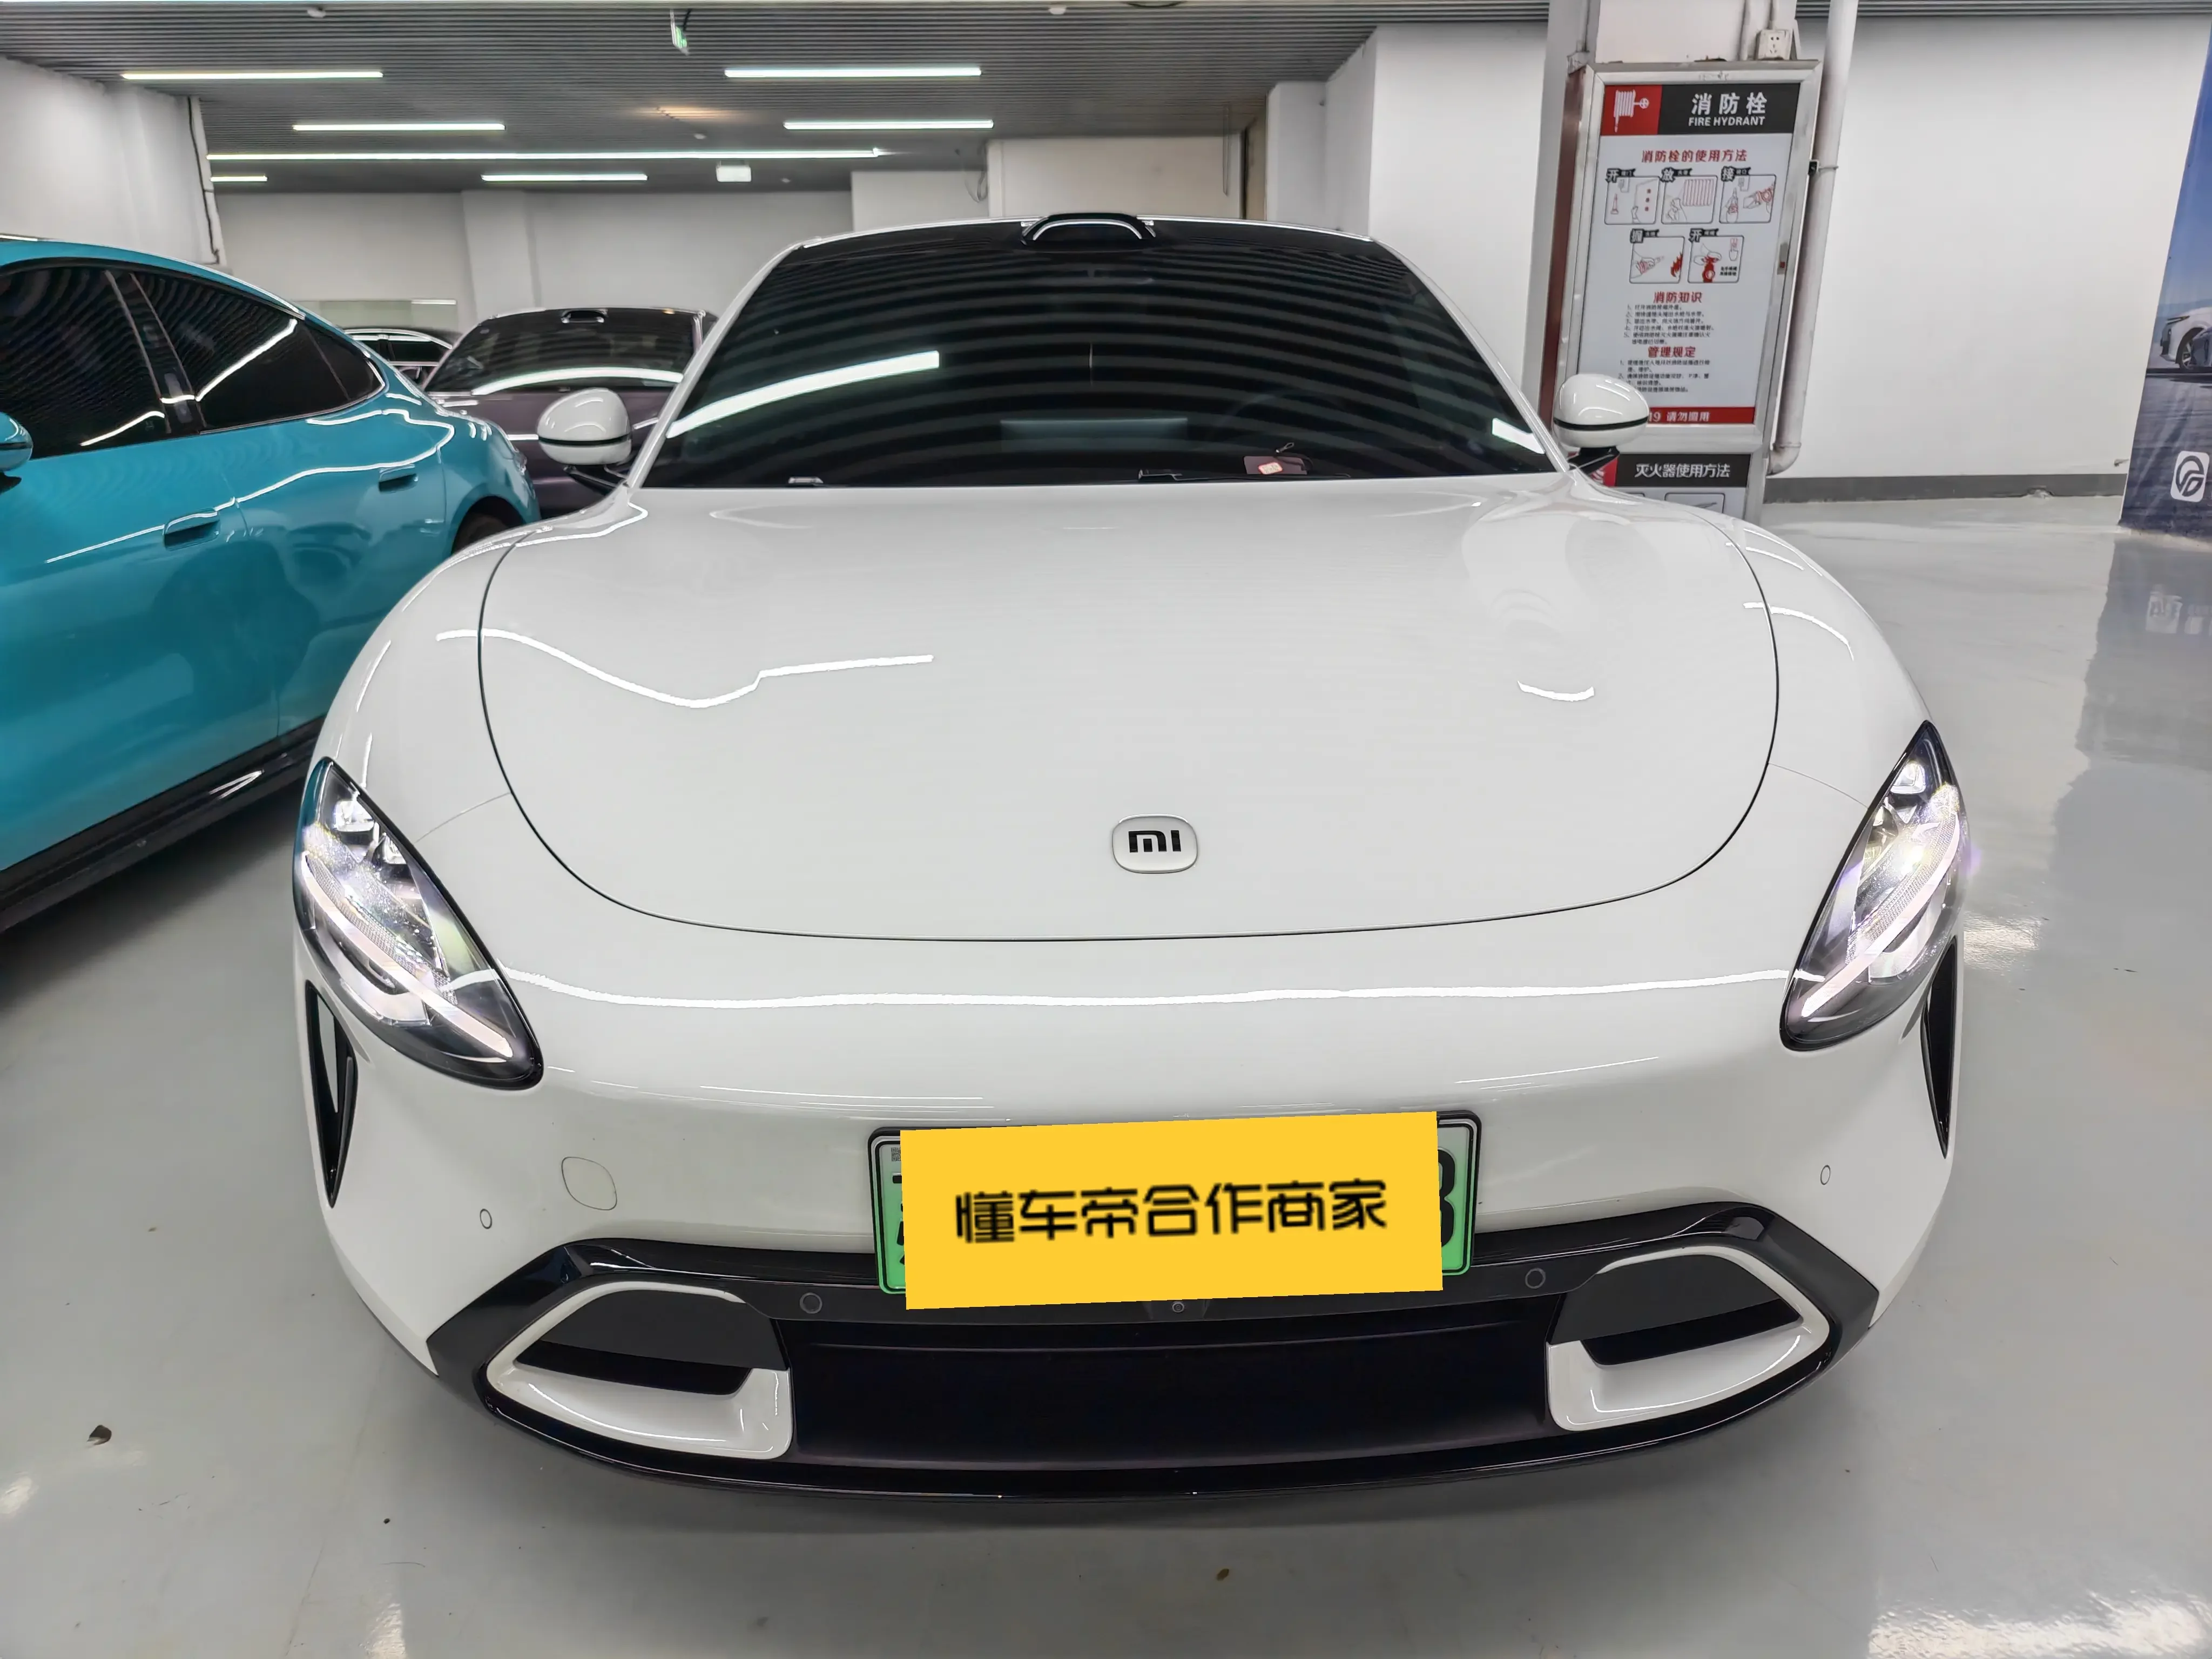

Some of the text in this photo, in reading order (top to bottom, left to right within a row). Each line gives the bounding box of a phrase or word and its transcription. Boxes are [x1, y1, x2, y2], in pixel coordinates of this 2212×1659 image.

[1691, 92, 1767, 115] 消防栓
[1688, 116, 1765, 126] FIRE HYDRANT
[1642, 149, 1748, 163] 消防栓的使用方法
[1653, 291, 1702, 304] 消防知识
[1648, 346, 1696, 358] 管理规定
[1634, 463, 1730, 478] 灭火器使用方法
